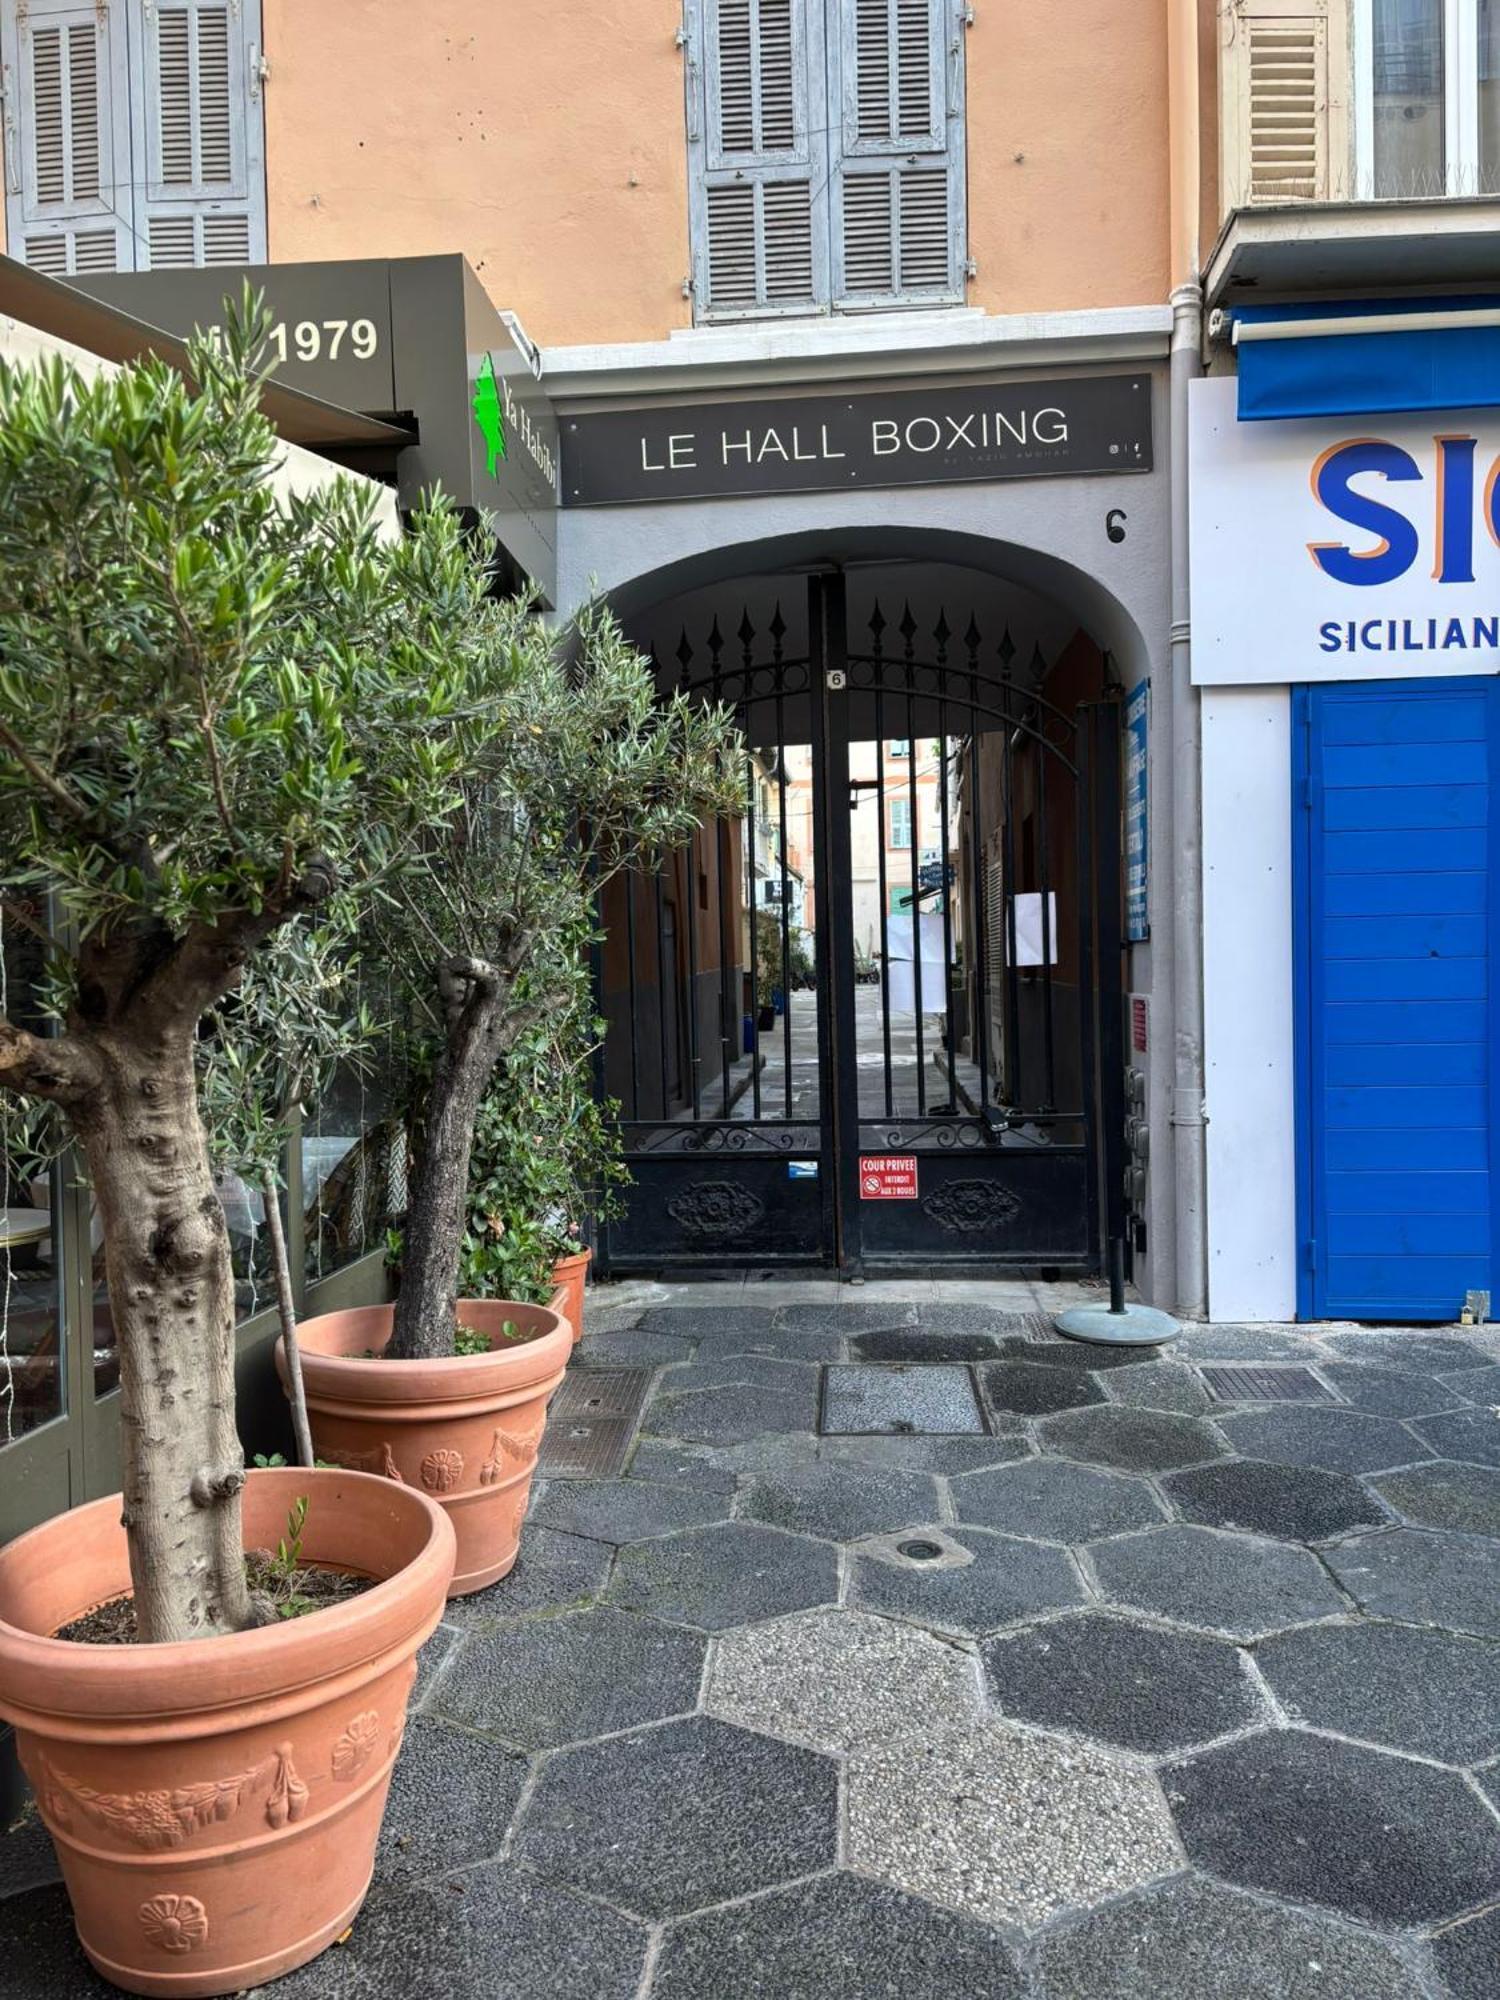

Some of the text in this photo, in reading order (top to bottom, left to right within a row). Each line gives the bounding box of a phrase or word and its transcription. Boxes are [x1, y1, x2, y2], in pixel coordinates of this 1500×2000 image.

[268, 318, 378, 362] 1979
[502, 375, 517, 432] Ya
[520, 405, 557, 489] Habibi
[641, 407, 1068, 471] LE HALL BOXING
[1105, 508, 1127, 544] 6
[1306, 434, 1500, 587] SI
[1319, 616, 1500, 653] SICILIAN
[832, 672, 841, 686] 6
[862, 1158, 914, 1172] COUR PRIVEE
